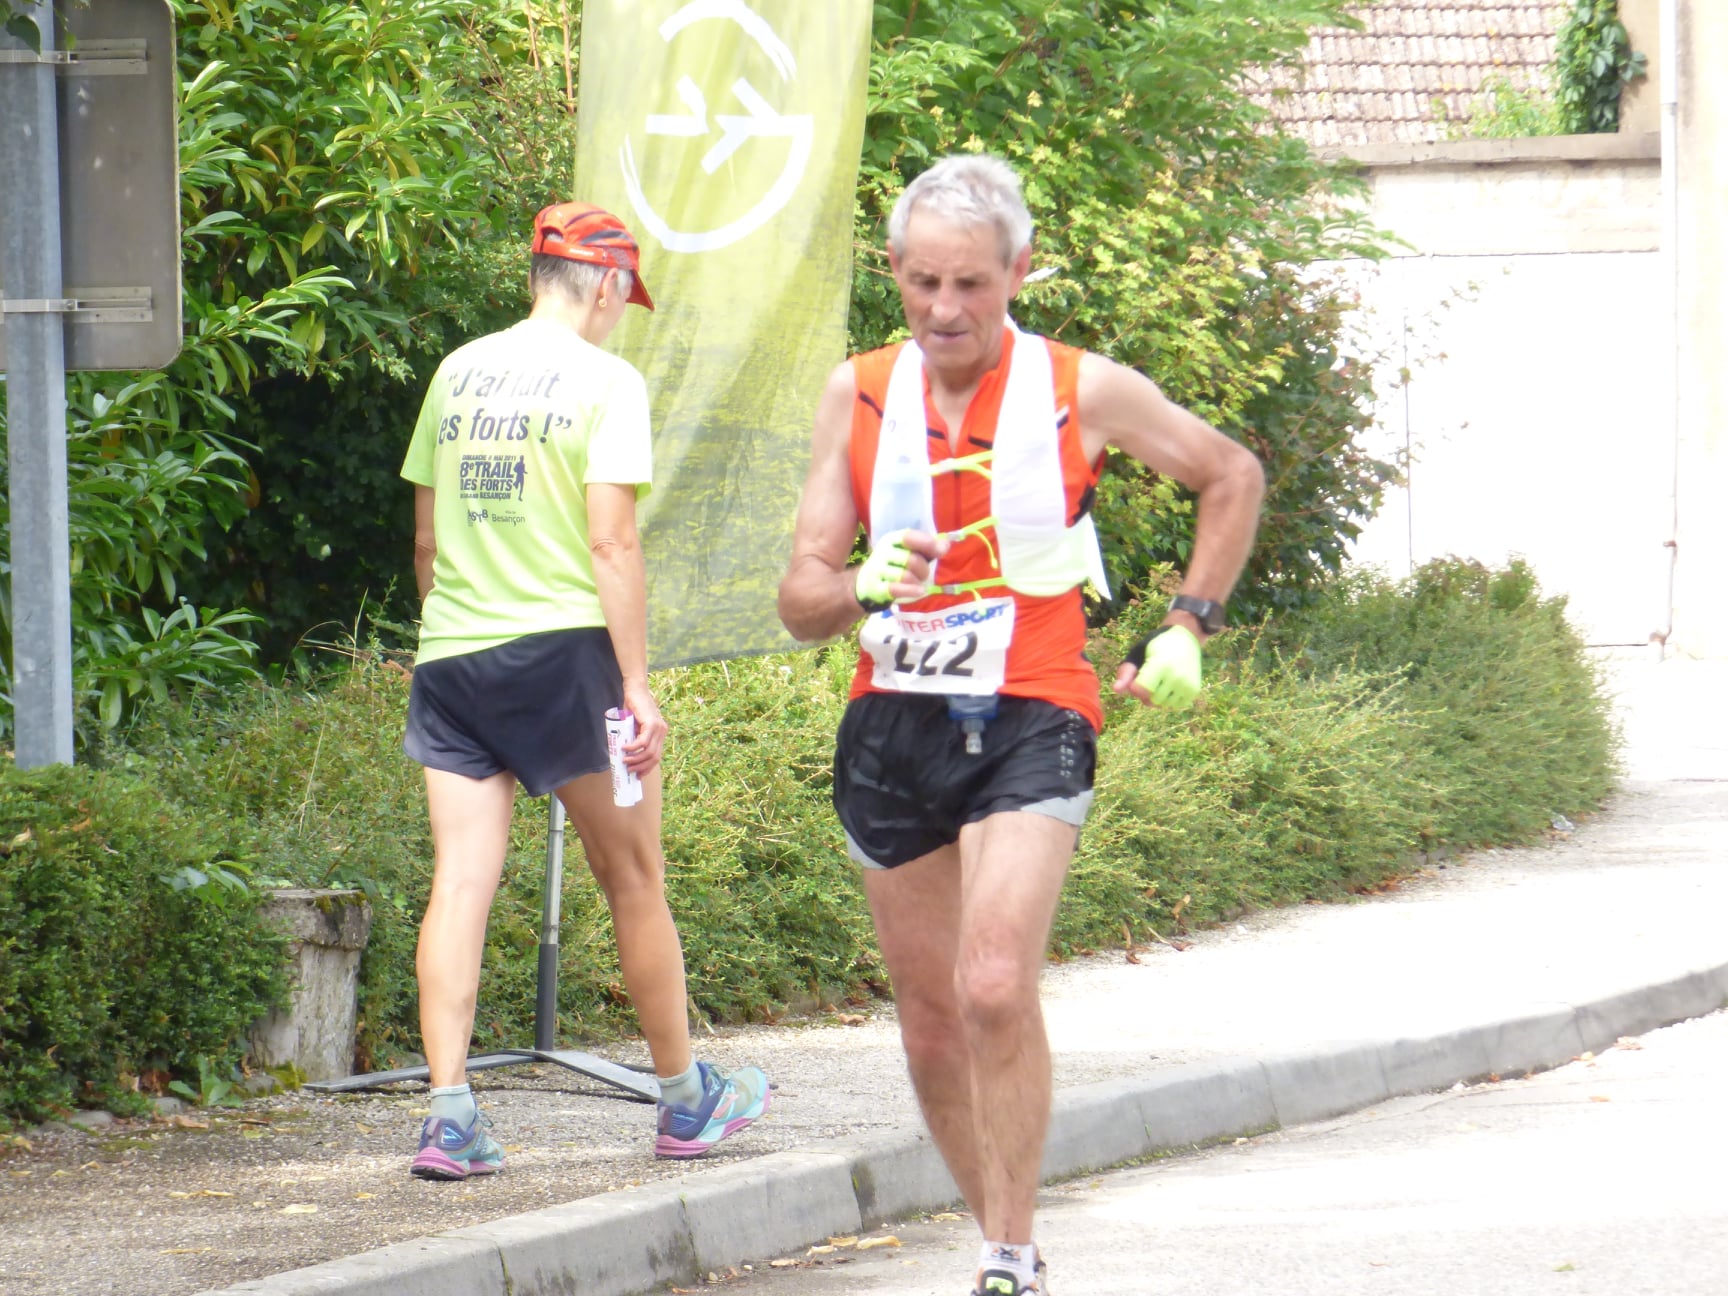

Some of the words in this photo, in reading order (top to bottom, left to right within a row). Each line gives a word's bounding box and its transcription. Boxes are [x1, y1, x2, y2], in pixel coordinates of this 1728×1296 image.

[469, 407, 530, 441] forts
[479, 478, 513, 492] FORTS
[491, 513, 526, 526] Besançon
[898, 604, 1007, 633] TERSPORT
